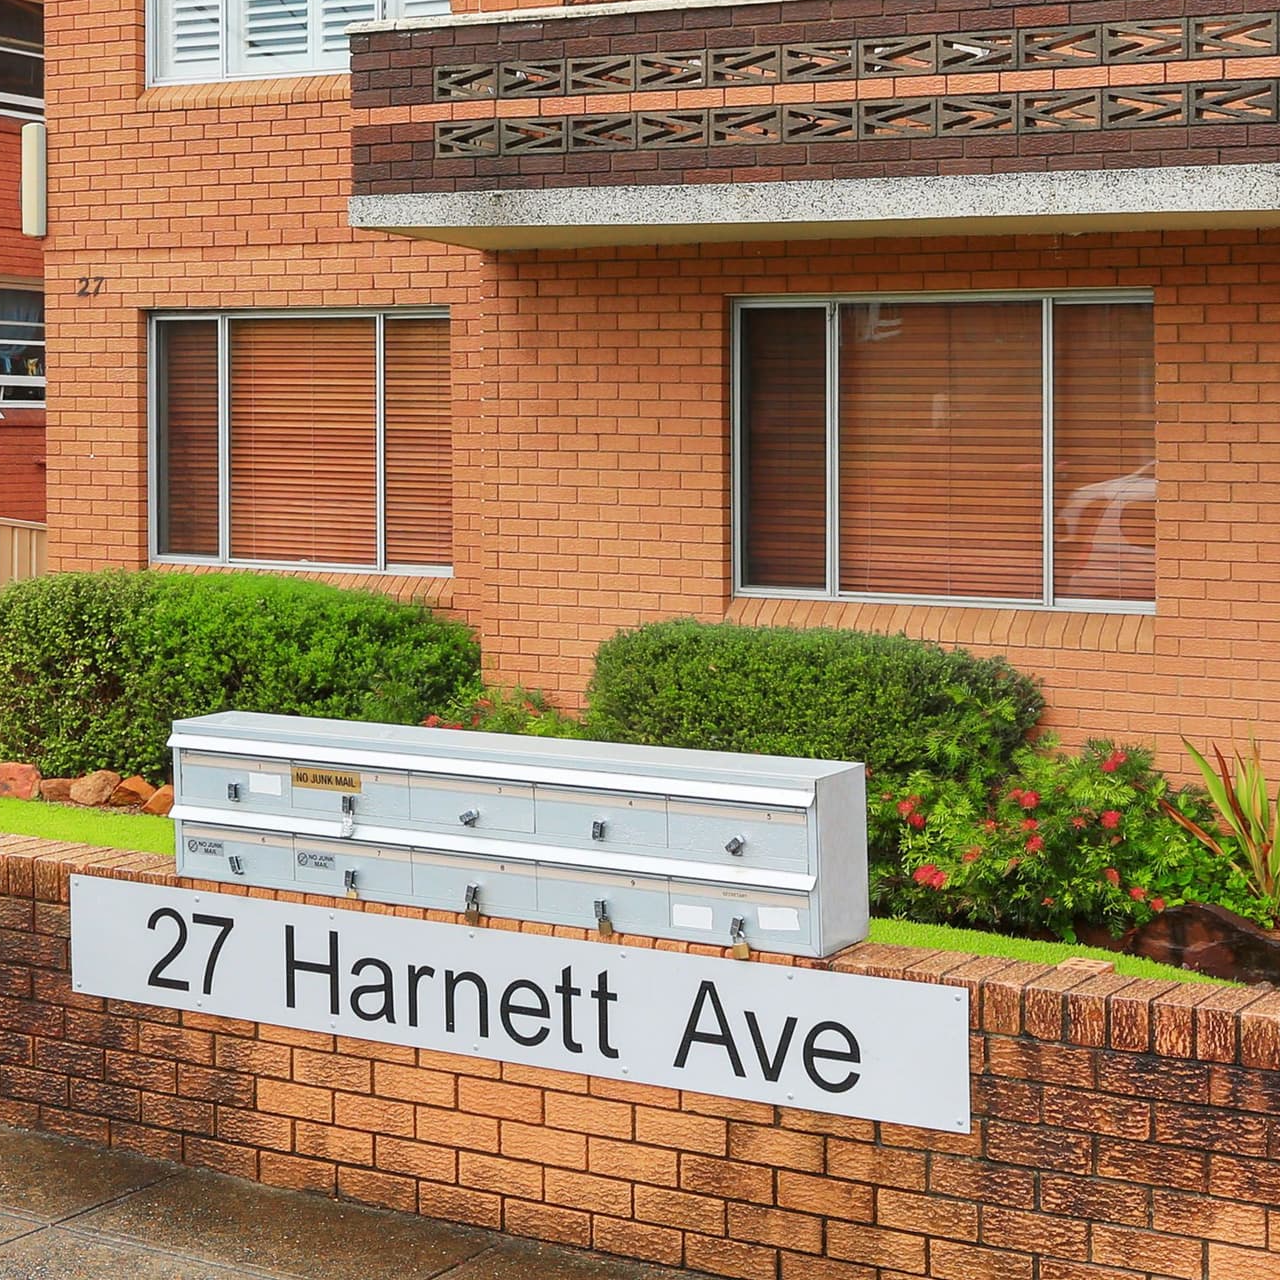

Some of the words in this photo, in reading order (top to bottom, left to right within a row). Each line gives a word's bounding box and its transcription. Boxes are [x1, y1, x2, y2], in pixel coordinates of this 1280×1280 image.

[77, 276, 104, 297] 27
[295, 772, 309, 783] NO
[310, 773, 334, 786] JUNK
[335, 776, 356, 788] MAIL
[308, 853, 317, 861] NO
[317, 855, 335, 863] JUNK
[314, 861, 329, 869] MAIL
[148, 907, 233, 994] 27
[285, 924, 618, 1058] Harnett
[674, 980, 860, 1093] Ave
